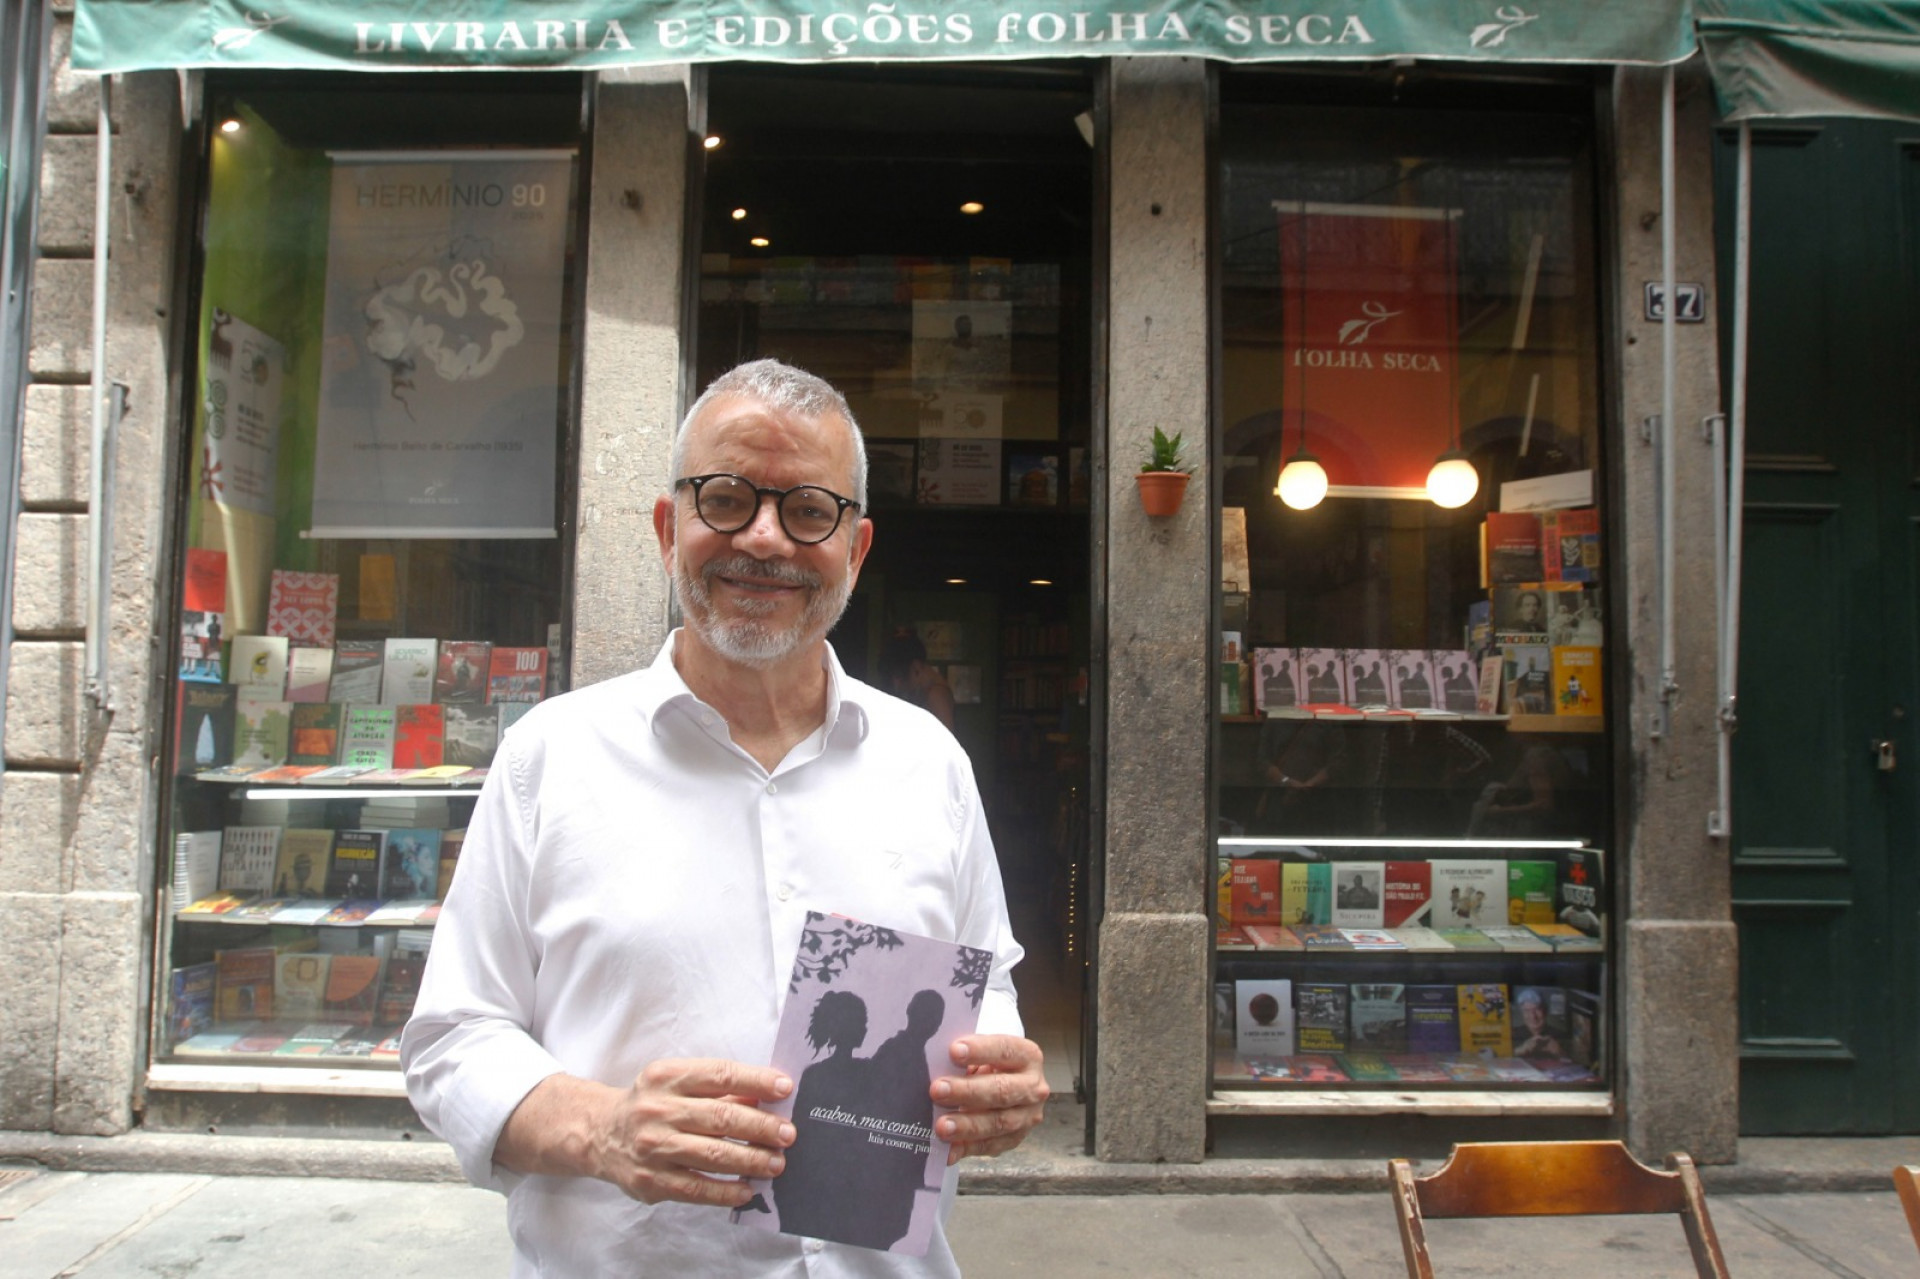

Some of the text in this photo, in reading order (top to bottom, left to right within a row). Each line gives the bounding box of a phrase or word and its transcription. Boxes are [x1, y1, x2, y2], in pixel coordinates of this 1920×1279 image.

[352, 2, 1376, 54] LIVRARIA E EDIÇÕES FOLHA SECA
[512, 183, 546, 207] 90
[1293, 348, 1442, 372] FOLHA SECA
[515, 651, 539, 671] 100
[809, 1105, 858, 1128] acabou,
[859, 1116, 886, 1130] mas
[868, 1132, 884, 1145] luis
[885, 1137, 914, 1151] cosme
